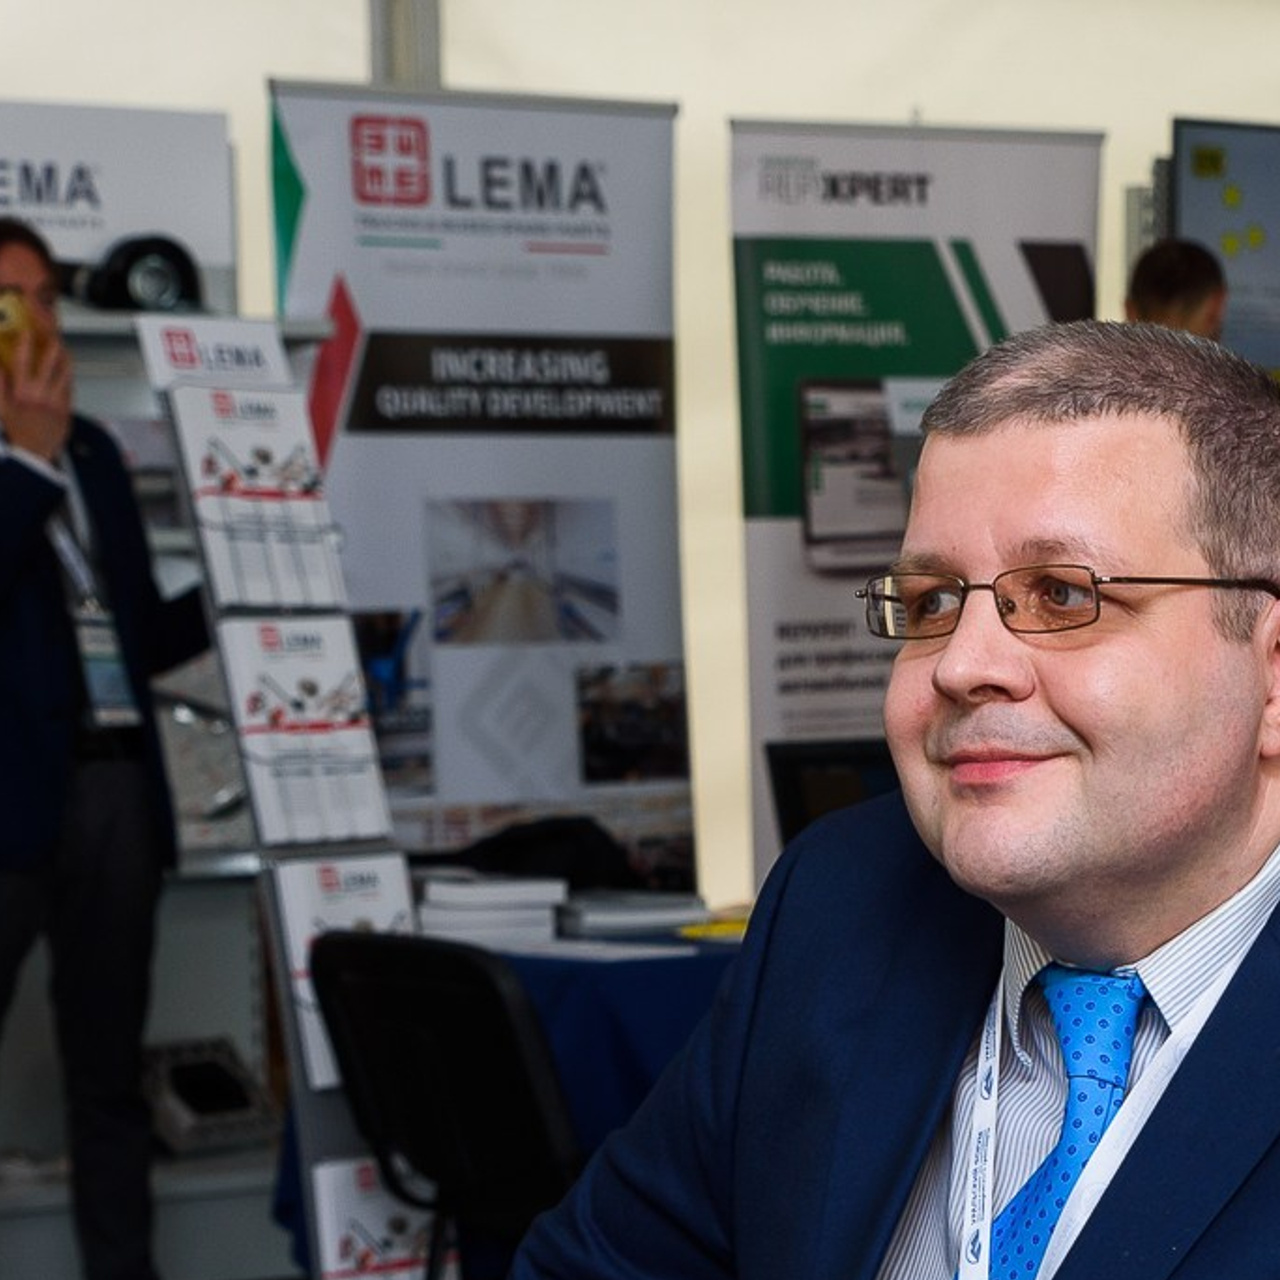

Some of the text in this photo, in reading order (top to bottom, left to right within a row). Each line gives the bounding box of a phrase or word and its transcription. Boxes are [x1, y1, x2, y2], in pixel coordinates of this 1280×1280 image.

[442, 153, 610, 212] LEMA
[430, 346, 610, 384] INCREASING
[375, 383, 664, 420] QUALITY DEVELOPMENT
